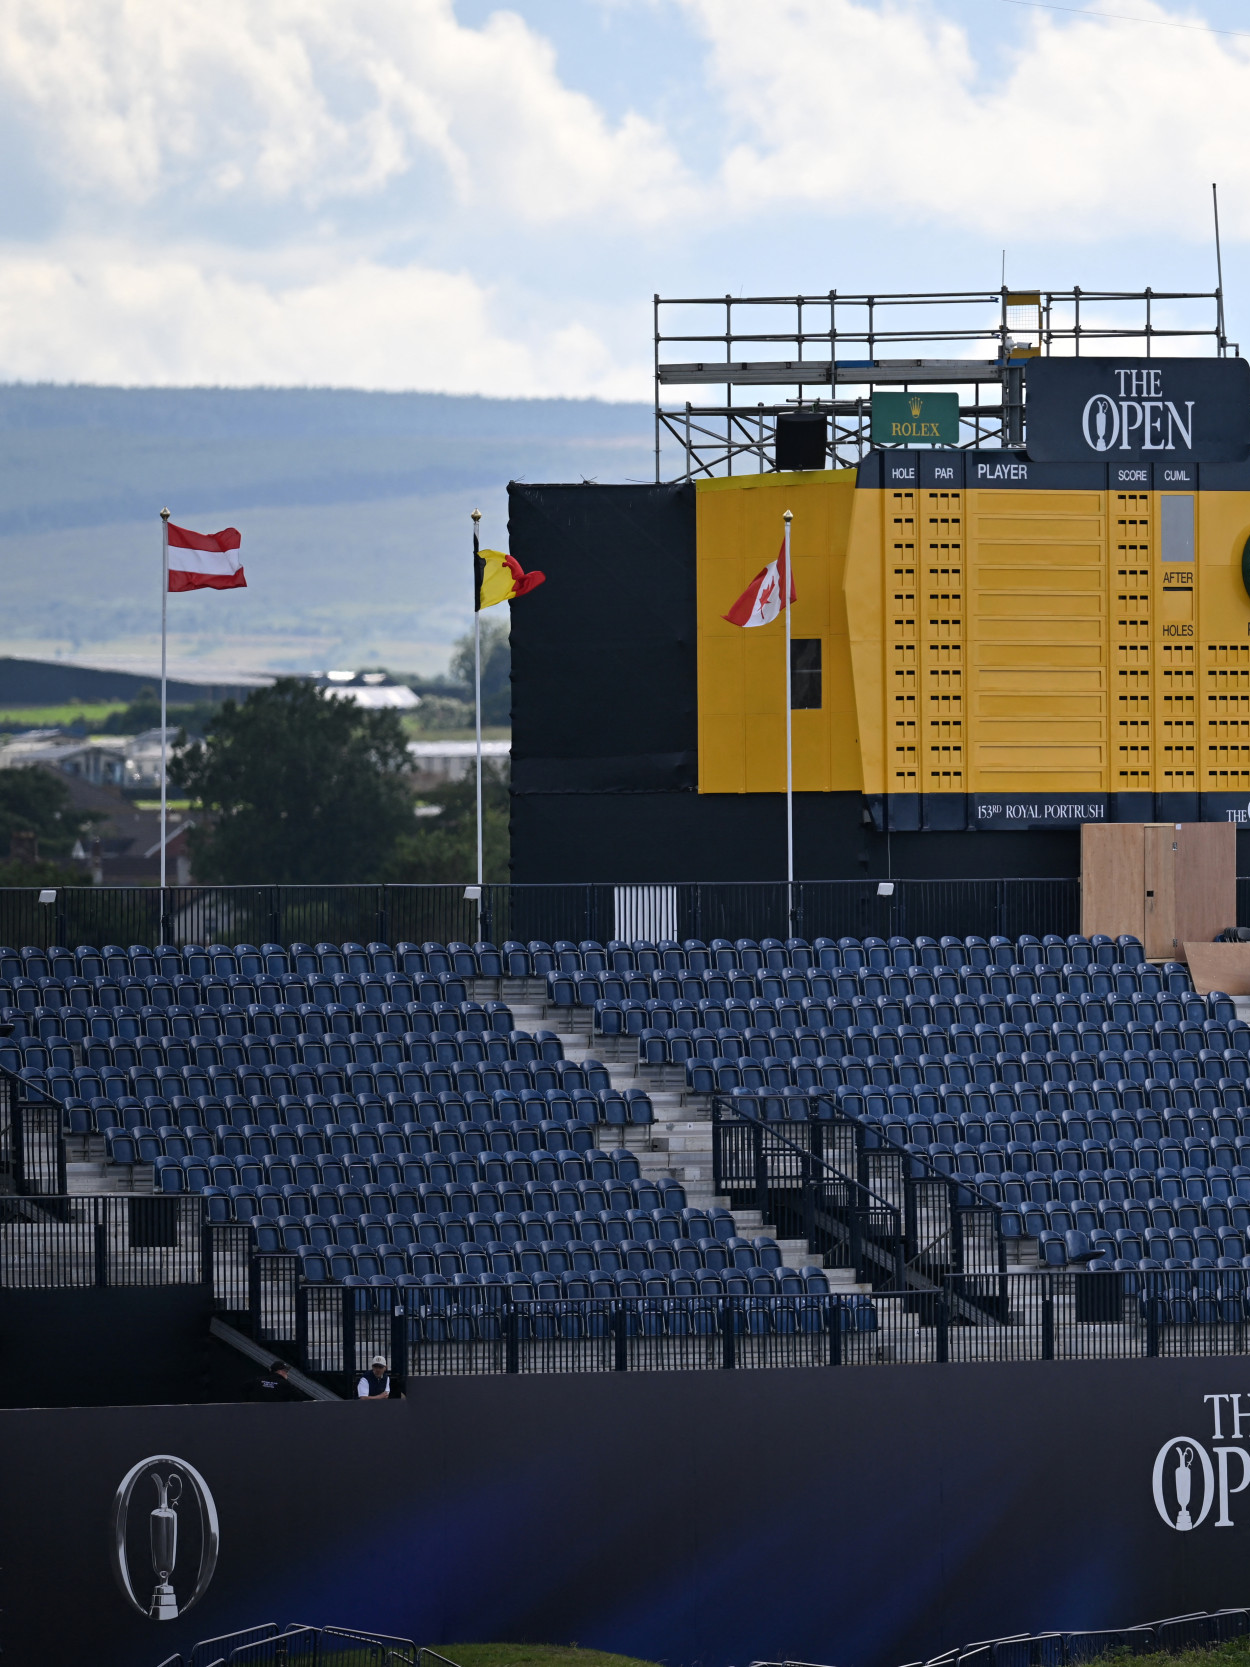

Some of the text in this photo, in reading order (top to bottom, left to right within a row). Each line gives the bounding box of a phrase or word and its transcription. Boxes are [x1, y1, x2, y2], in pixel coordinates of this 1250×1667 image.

[1115, 369, 1163, 398] THE
[891, 422, 941, 437] ROLEX
[1082, 393, 1196, 452] OPEN
[891, 467, 915, 480] HOLE
[934, 467, 954, 480] PAR
[977, 464, 1028, 481] PLAYER
[1118, 469, 1148, 481] SCORE
[1163, 571, 1194, 584] AFTER
[1162, 624, 1194, 638] HOLES
[977, 804, 1105, 819] 153RD ROYAL PORTRUSH
